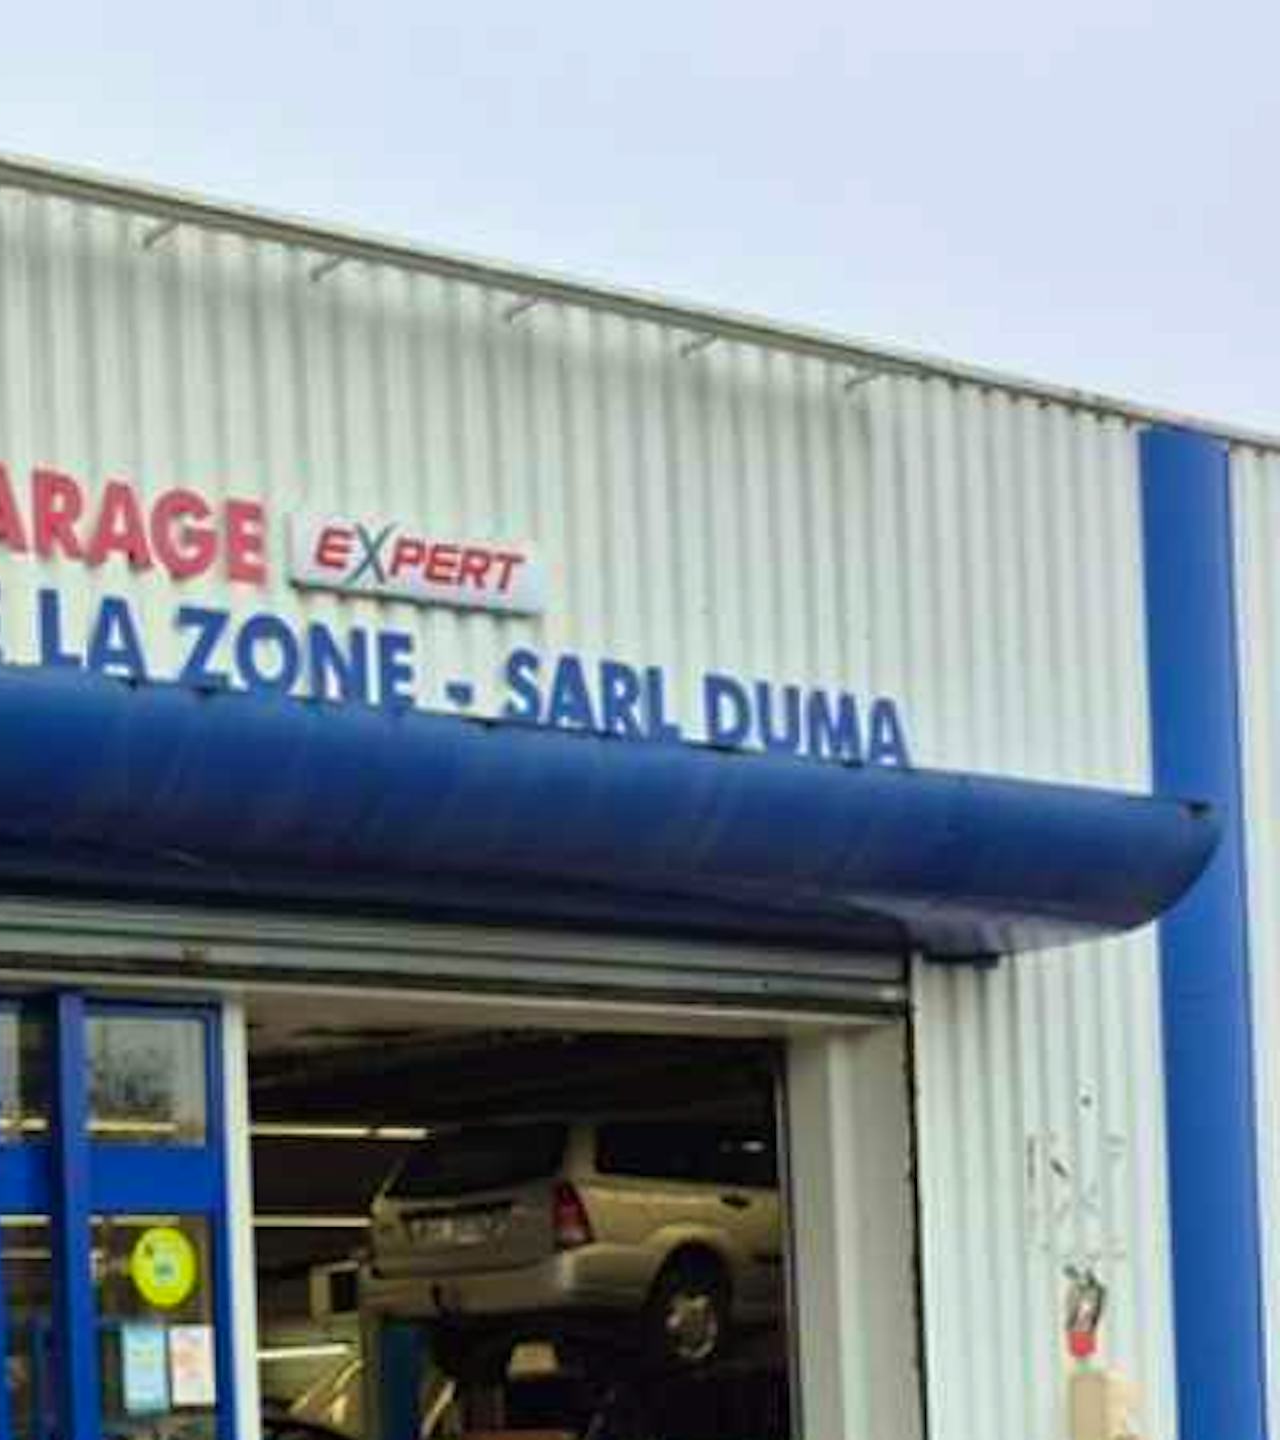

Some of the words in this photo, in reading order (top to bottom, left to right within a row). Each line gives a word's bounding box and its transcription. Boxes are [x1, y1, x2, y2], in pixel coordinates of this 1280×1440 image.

[37, 588, 147, 684] LA
[175, 604, 416, 706] ZONE
[504, 645, 682, 740] SARL
[704, 670, 912, 767] DUMA
